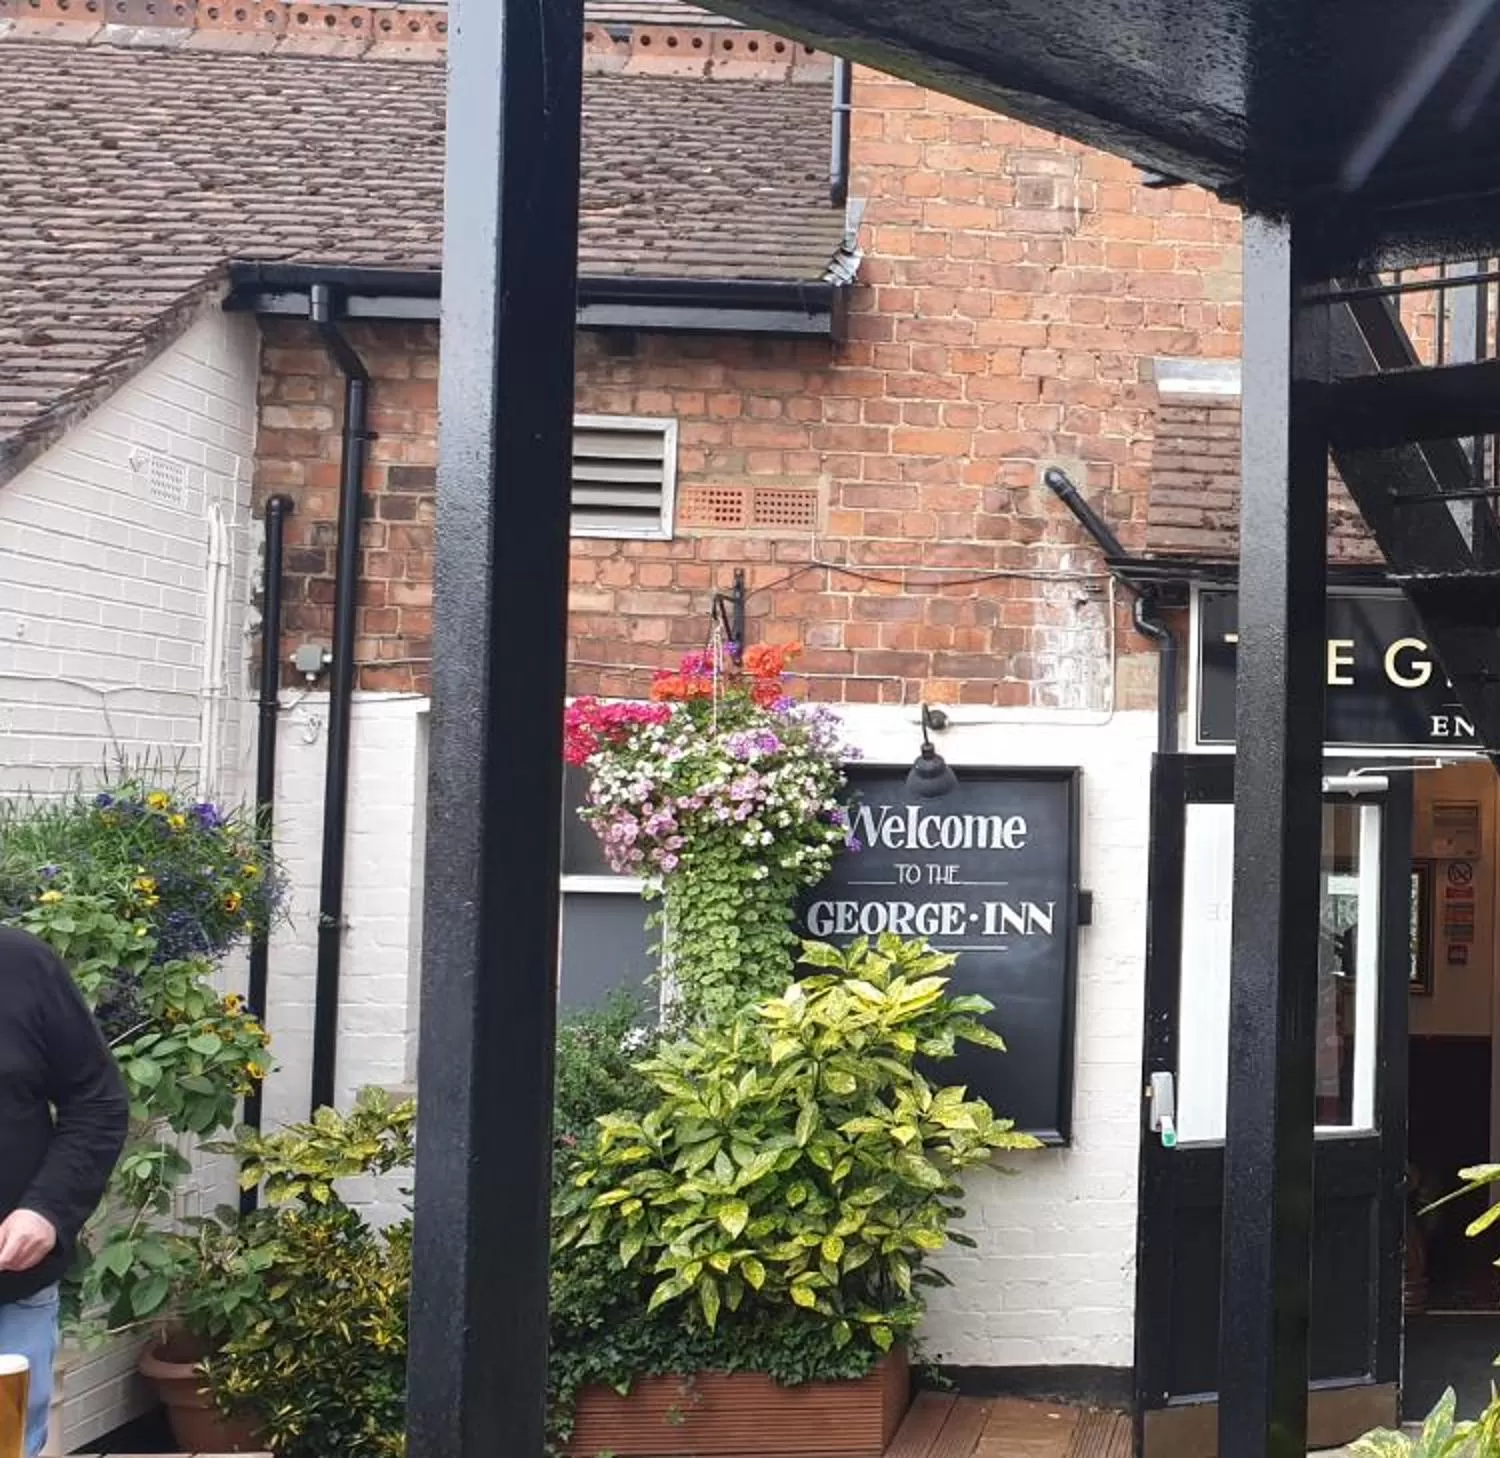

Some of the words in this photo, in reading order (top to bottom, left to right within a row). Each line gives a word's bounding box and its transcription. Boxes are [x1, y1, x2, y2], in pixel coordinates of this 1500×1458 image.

[843, 804, 1027, 849] Welcome
[894, 863, 922, 885] TO
[925, 863, 961, 885] THE
